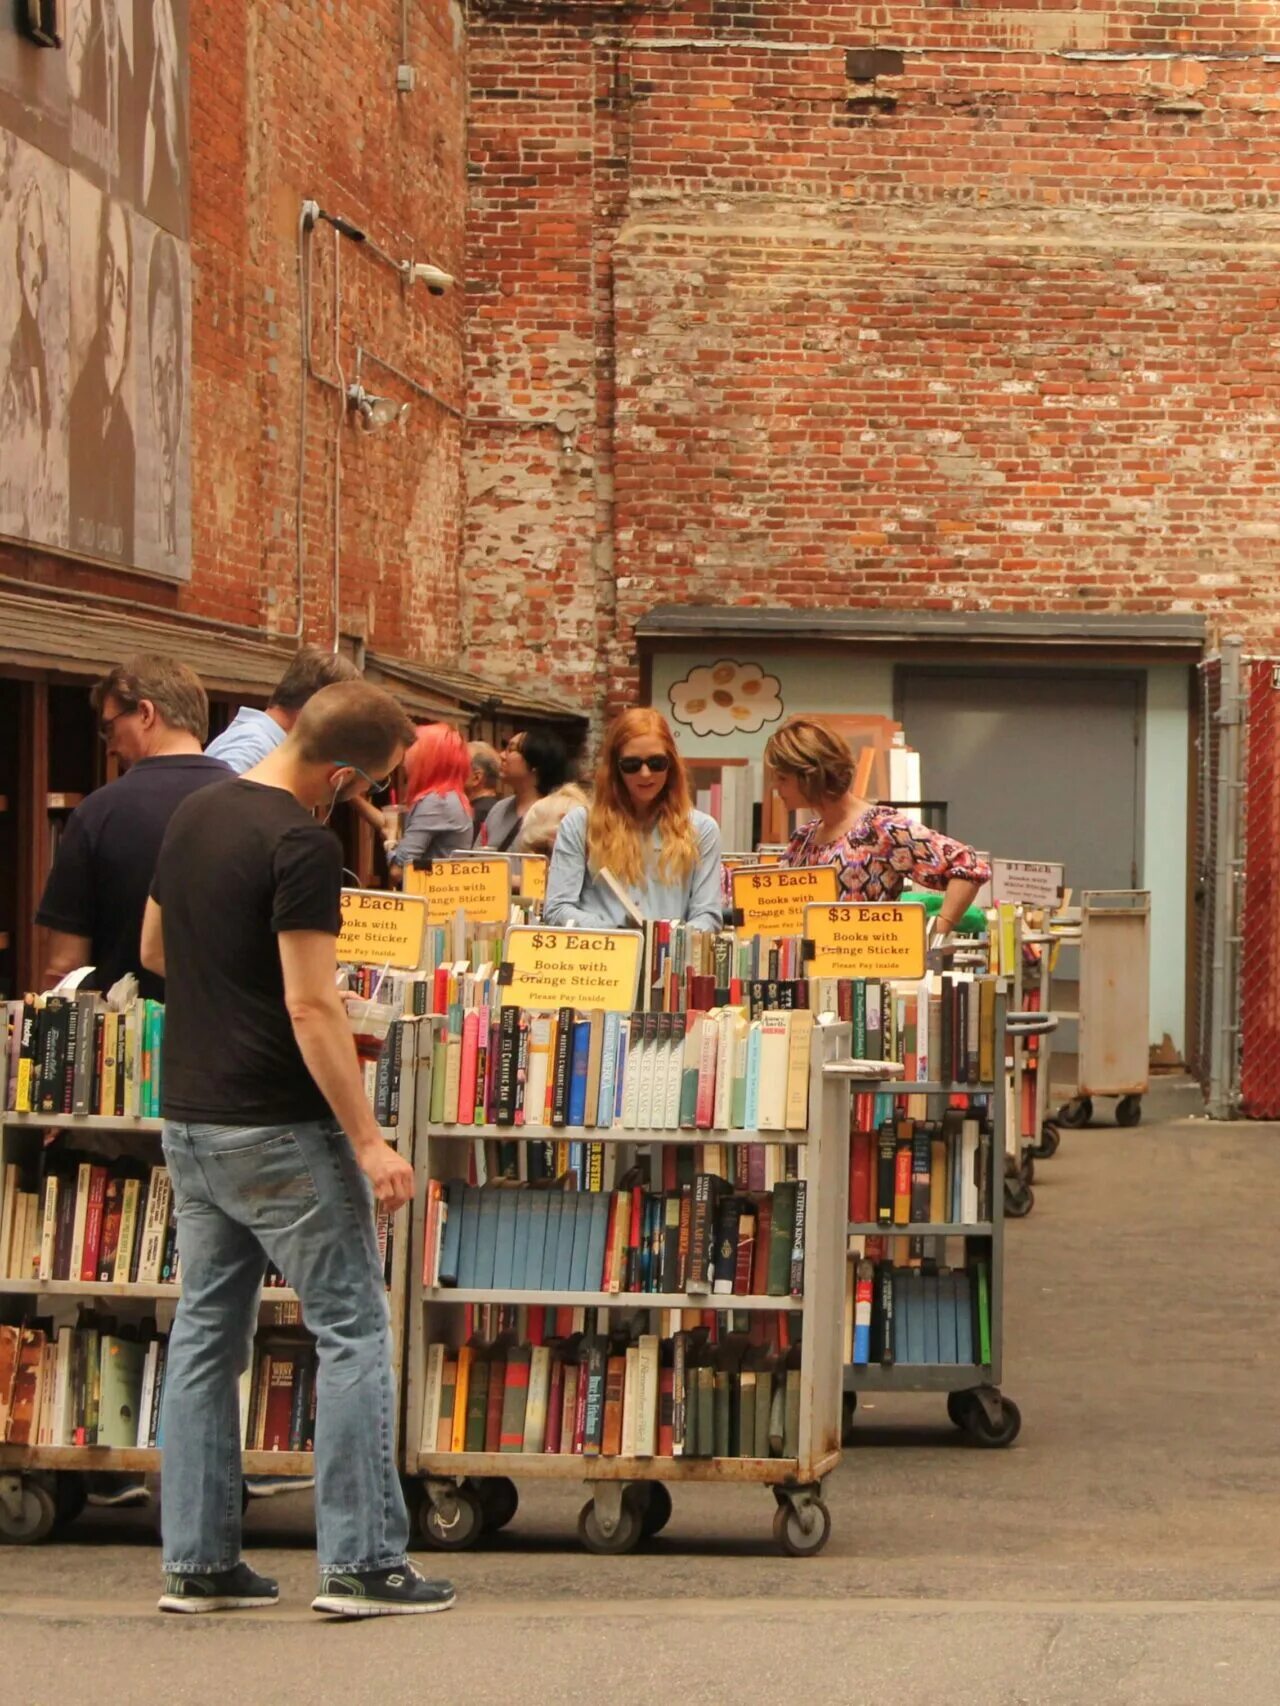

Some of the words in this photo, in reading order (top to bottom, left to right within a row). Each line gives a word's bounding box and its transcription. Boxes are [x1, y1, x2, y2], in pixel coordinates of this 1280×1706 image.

[451, 862, 490, 875] Each
[464, 883, 486, 891] with
[752, 874, 772, 889] $3
[778, 872, 817, 886] Each
[359, 896, 404, 911] Each
[758, 896, 788, 905] Books
[792, 894, 814, 902] with
[828, 907, 850, 923] $3
[858, 908, 903, 922] Each
[372, 920, 397, 930] with
[365, 932, 408, 943] Sticker
[532, 932, 557, 950] $3
[566, 935, 615, 951] Each
[833, 932, 868, 941] Books
[872, 932, 898, 941] with
[868, 946, 910, 954] Sticker
[534, 960, 574, 970] Books
[579, 962, 607, 971] with
[520, 974, 566, 987] Orange
[571, 976, 619, 987] Sticker
[529, 992, 556, 1000] Please
[560, 994, 575, 1002] Pay
[579, 994, 605, 1002] Inside
[21, 1019, 33, 1047] Hockey
[795, 1191, 805, 1226] STEPHEN
[695, 1203, 706, 1241] PILLAR
[794, 1227, 803, 1249] KING
